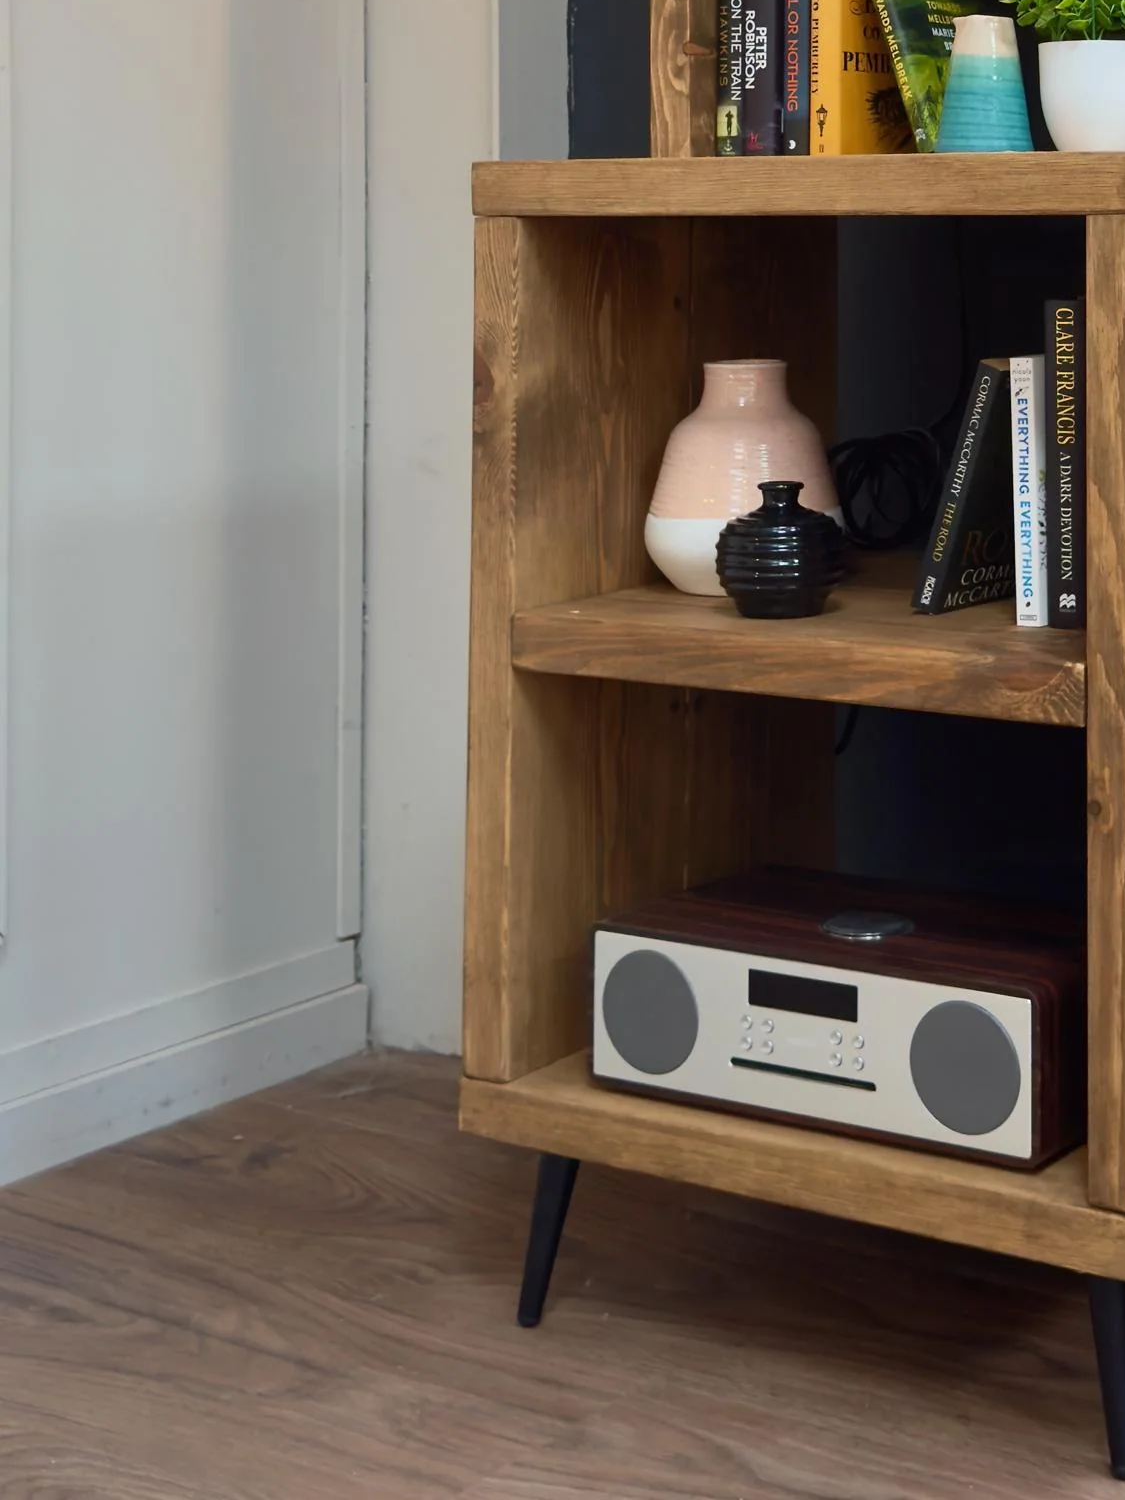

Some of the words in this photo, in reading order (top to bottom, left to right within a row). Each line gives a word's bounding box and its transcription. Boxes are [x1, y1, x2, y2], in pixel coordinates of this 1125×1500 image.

[787, 10, 799, 35] OR
[926, 0, 961, 14] TOWARDS
[719, 6, 729, 87] HAWKINS
[730, 23, 742, 54] THE
[745, 10, 756, 89] ROBINSON
[755, 26, 768, 71] PETER
[811, 18, 819, 94] PEMBERLEY
[730, 57, 742, 101] TRAIN
[787, 39, 799, 112] NOTHING
[886, 33, 913, 101] MELLBREAK
[1055, 307, 1074, 365] CLARE
[969, 375, 991, 429] CORMAC
[1056, 371, 1076, 445] FRANCIS
[1060, 451, 1071, 462] A
[1059, 465, 1072, 503] DARK
[942, 502, 957, 527] THE
[932, 527, 949, 563] ROAD
[1020, 501, 1034, 598] EVERYTHING
[1060, 507, 1073, 581] DEVOTION
[920, 575, 937, 605] PICADOR
